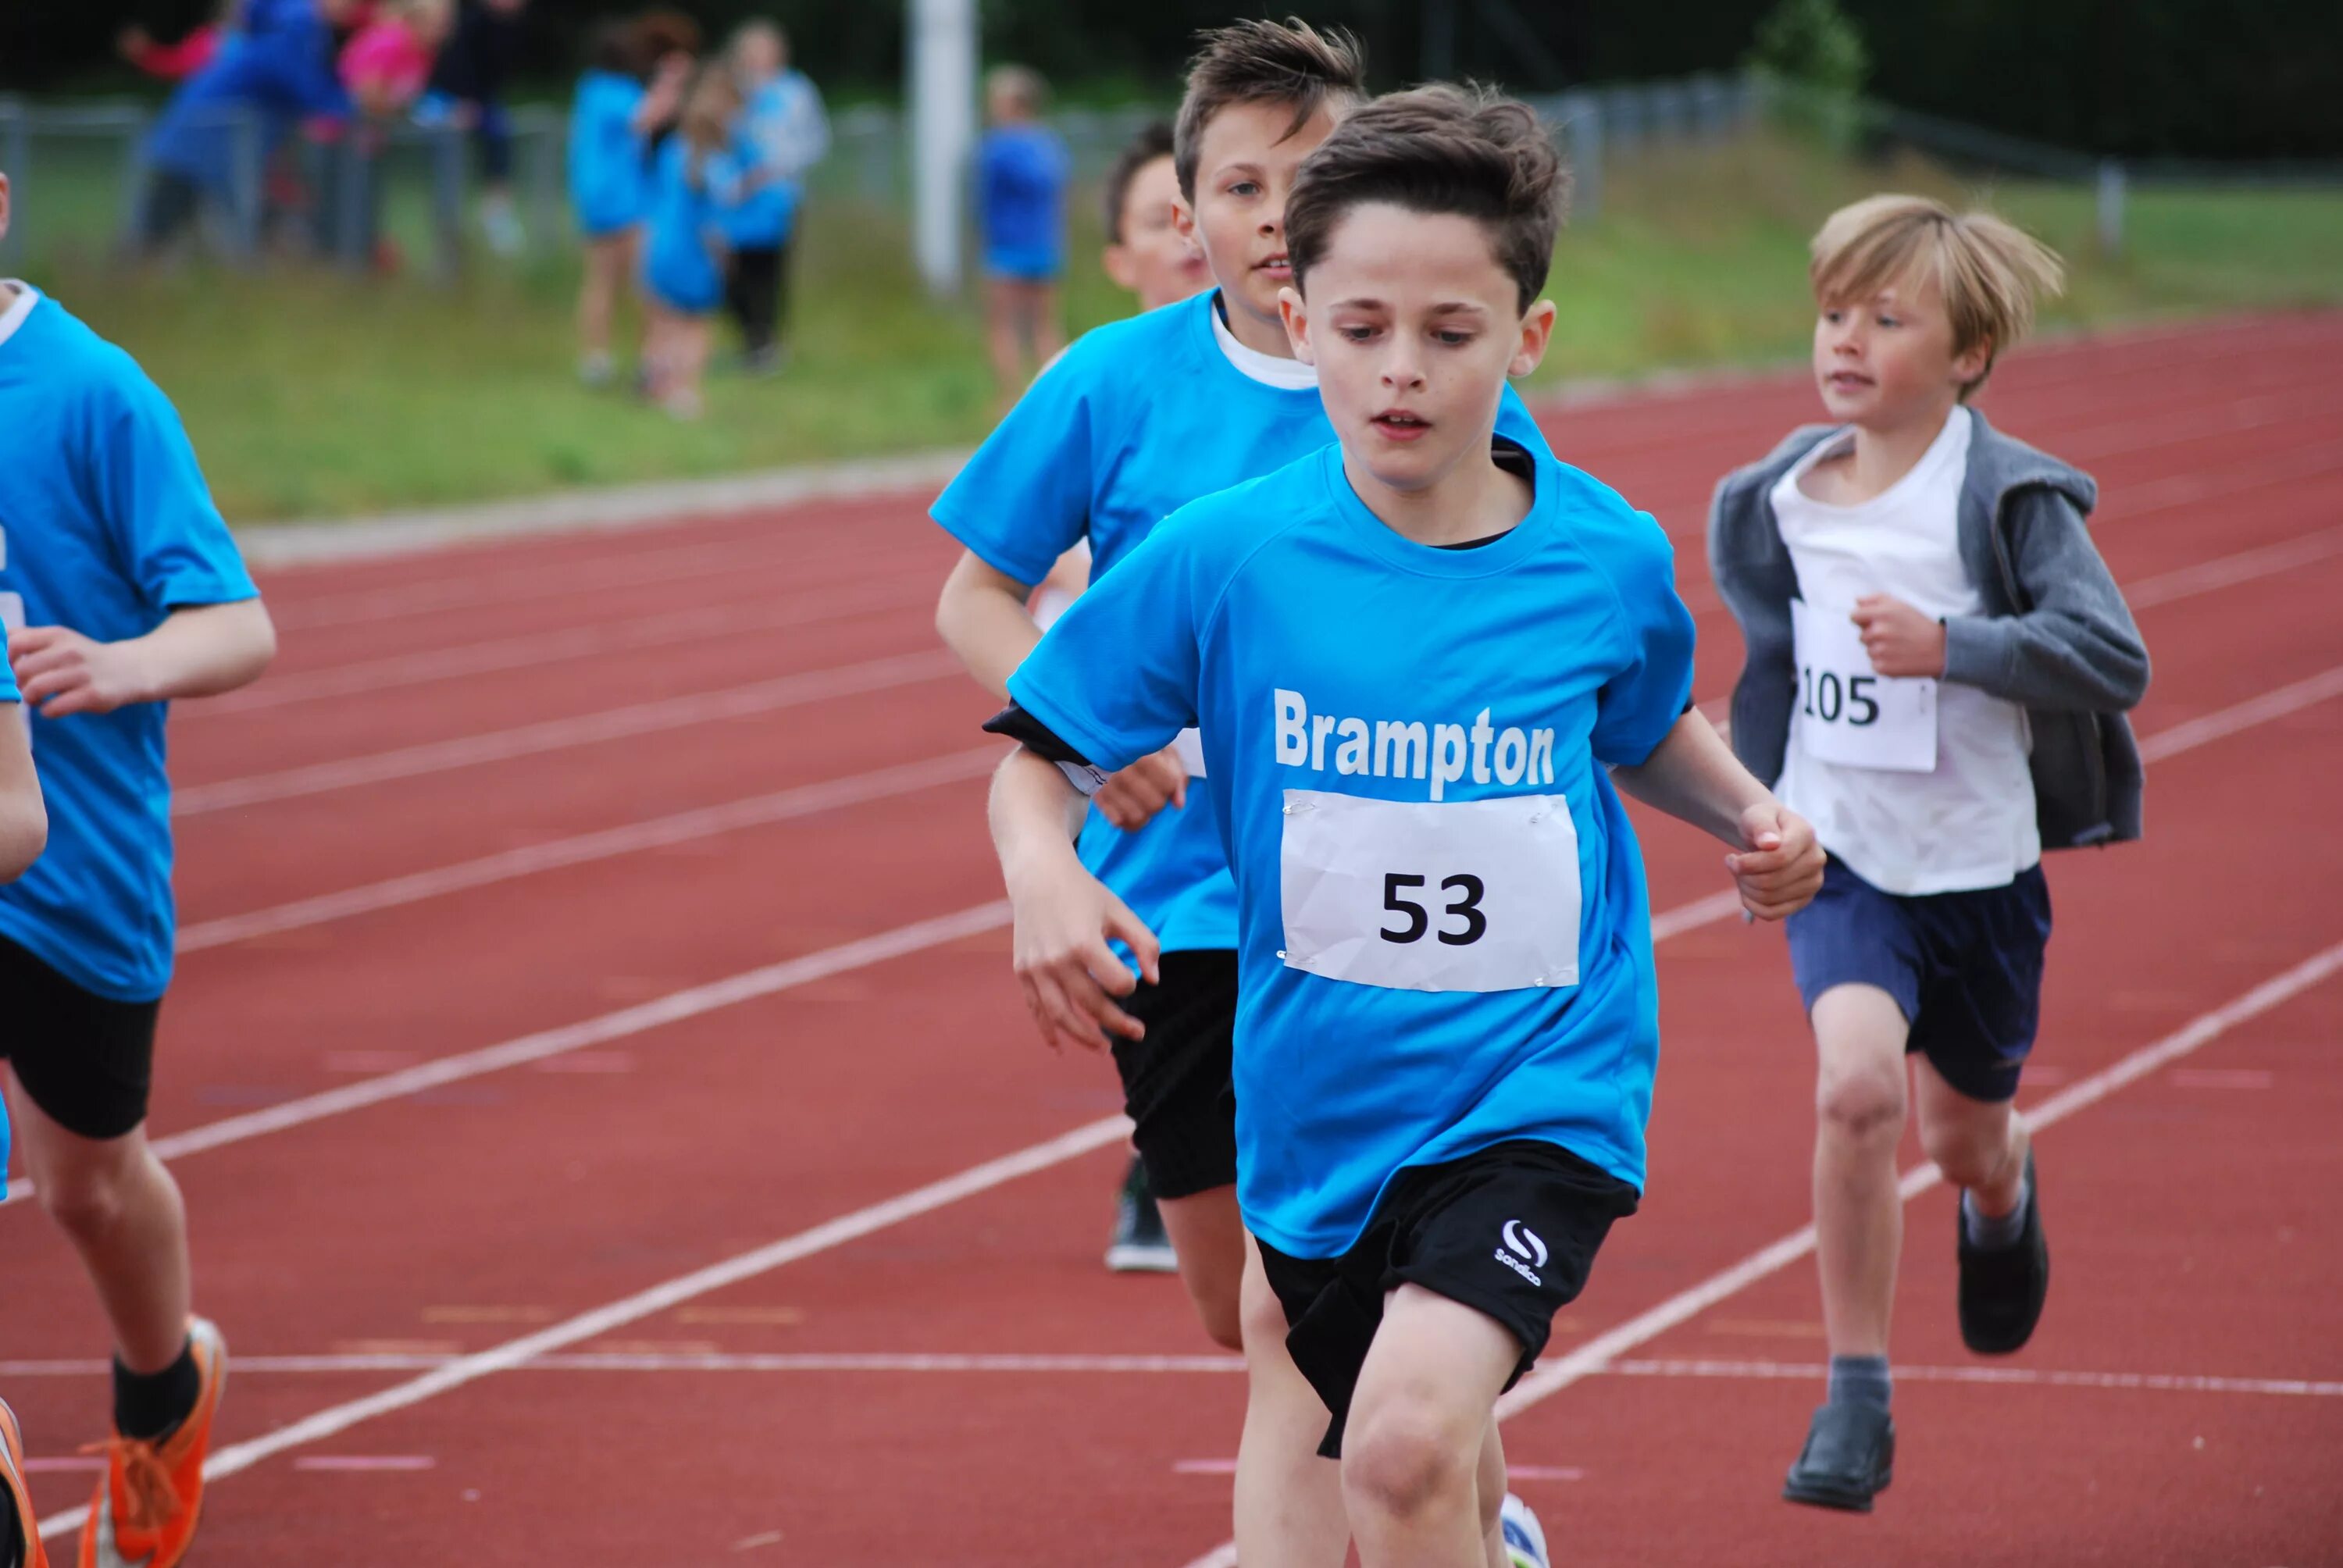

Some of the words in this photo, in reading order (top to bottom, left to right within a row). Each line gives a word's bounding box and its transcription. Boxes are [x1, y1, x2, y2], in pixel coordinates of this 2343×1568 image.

[1804, 667, 1879, 726] 105
[1274, 688, 1554, 801] Brampton
[1380, 873, 1486, 945] 53
